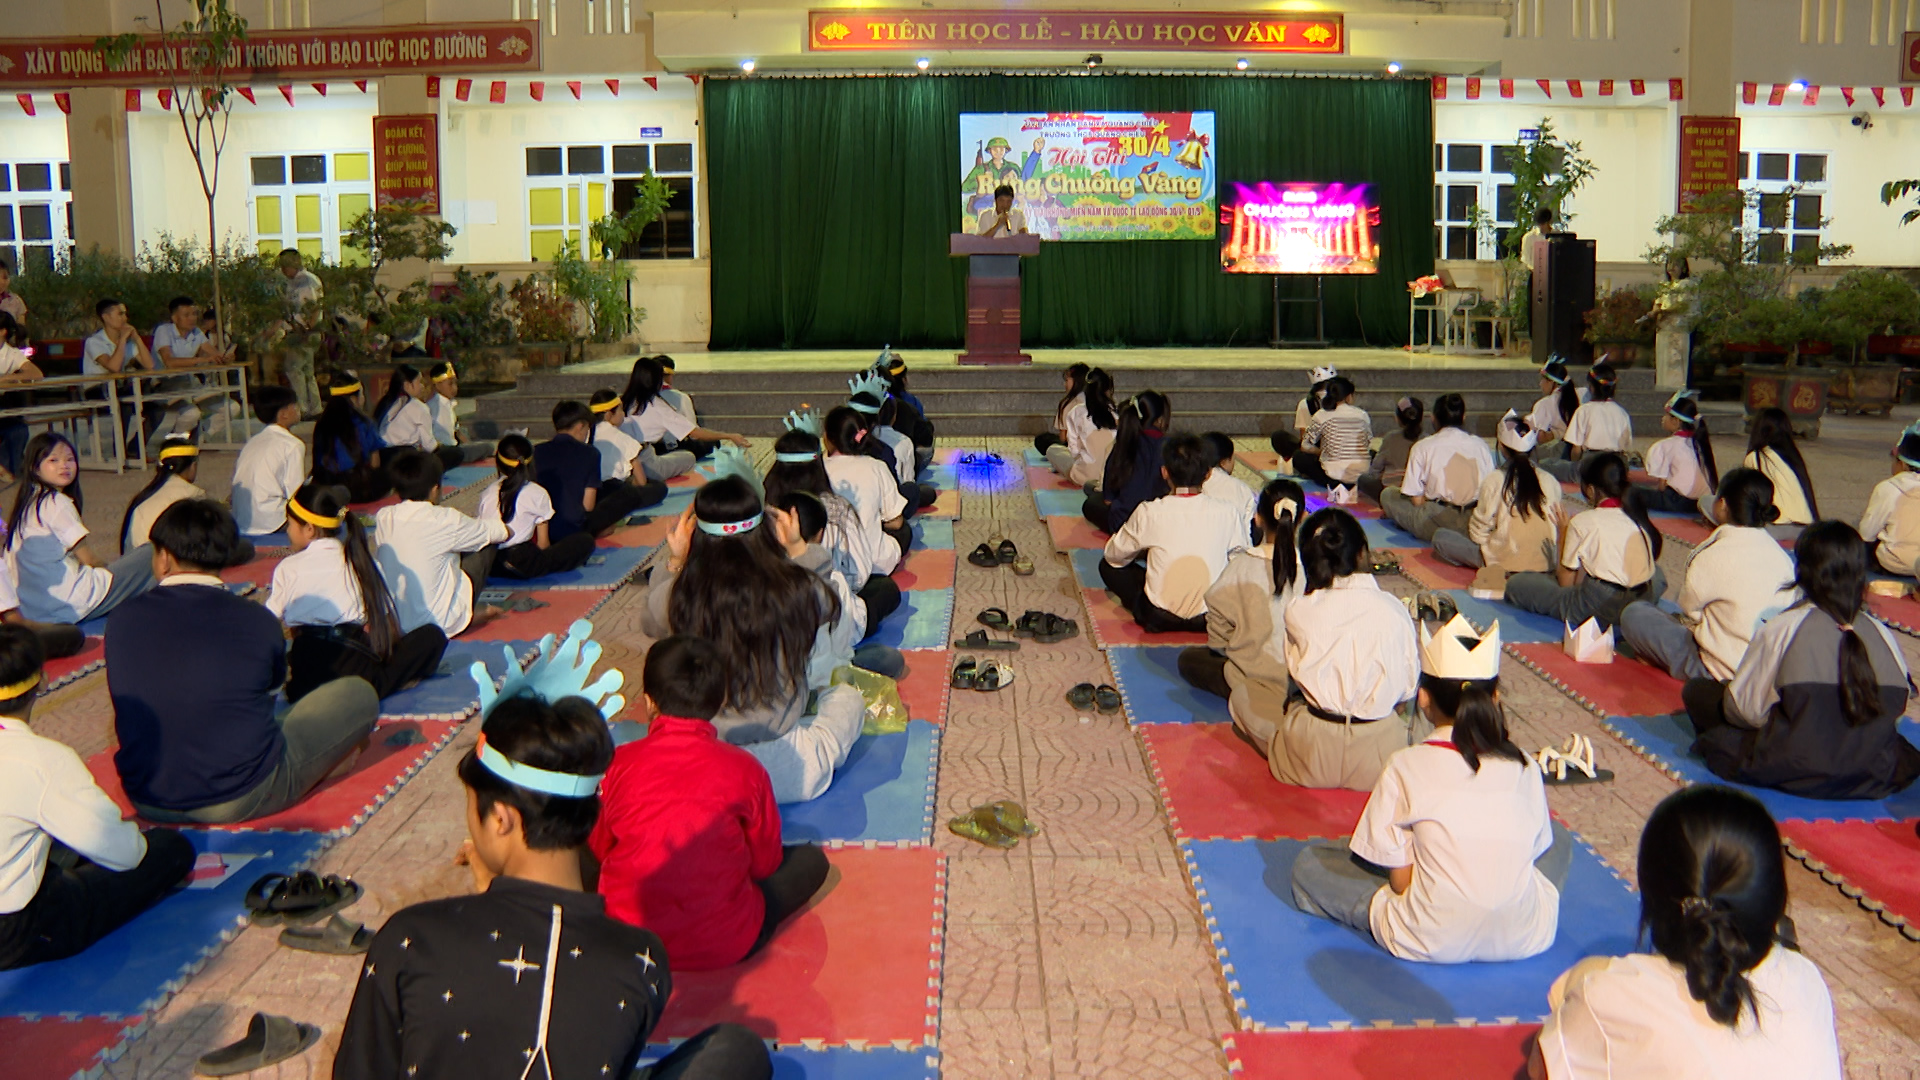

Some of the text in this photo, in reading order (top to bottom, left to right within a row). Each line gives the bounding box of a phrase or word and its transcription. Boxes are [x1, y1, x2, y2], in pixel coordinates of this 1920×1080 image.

[867, 18, 937, 40] TIÊN
[946, 22, 1010, 44] HỌC
[1019, 17, 1053, 40] LỄ
[1080, 19, 1143, 45] HẬU
[1153, 24, 1216, 46] HỌC
[1224, 21, 1288, 42] VĂN
[25, 47, 55, 74] XÂY
[60, 49, 103, 77] DỰNG
[146, 47, 178, 75] BẠN
[246, 40, 297, 68] KHÔNG
[301, 38, 326, 65] VỚI
[330, 41, 361, 68] BẠO
[366, 37, 394, 67] LỰC
[399, 37, 430, 65] HỌC
[434, 32, 487, 60] ĐƯỜNG
[385, 126, 407, 139] ĐOÀN
[1047, 146, 1128, 169] Hội Thi
[1118, 135, 1171, 158] 30/4
[1045, 171, 1136, 200] Chuông
[1138, 171, 1202, 200] Vàng
